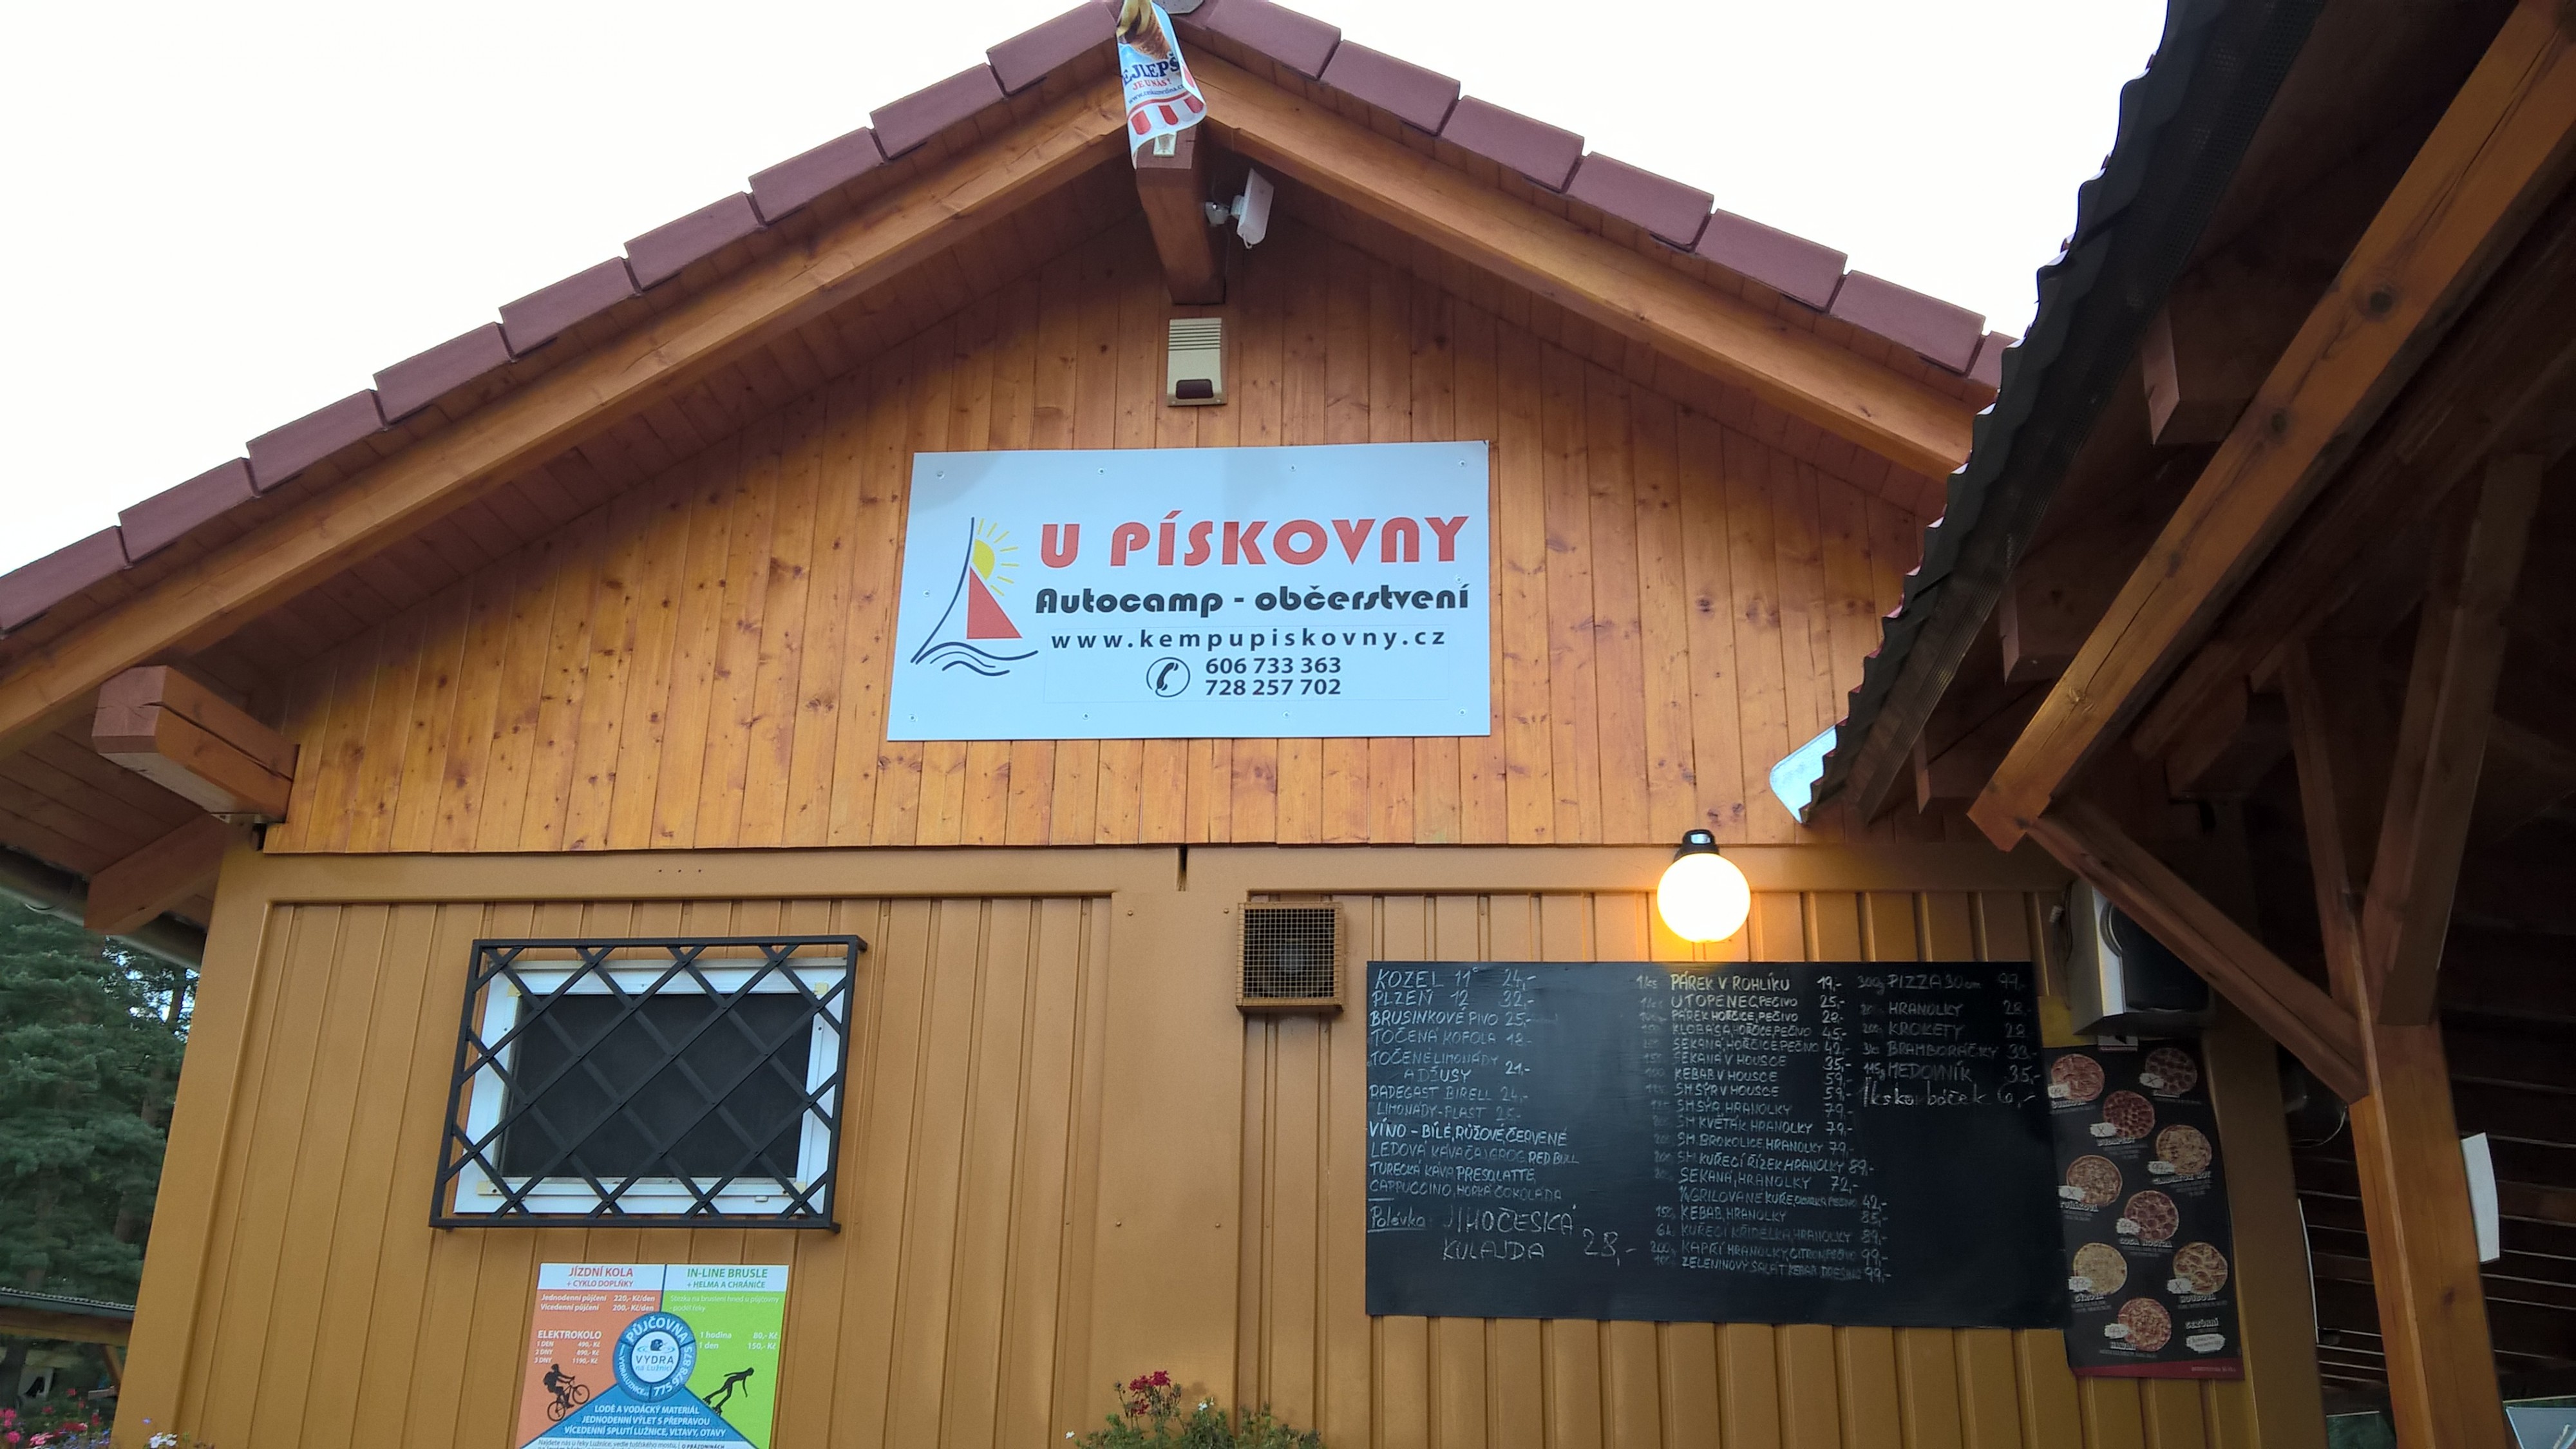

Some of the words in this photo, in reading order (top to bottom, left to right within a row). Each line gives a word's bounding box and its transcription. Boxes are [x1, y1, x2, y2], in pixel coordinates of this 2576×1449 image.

[1041, 523, 1080, 569] U
[1110, 509, 1470, 567] PÍSKOVNY
[1036, 587, 1224, 618] Autocamp
[1255, 584, 1470, 612] občerstvení
[1051, 626, 1447, 653] www.kempupiskovny.cz
[1206, 658, 1247, 674] 606
[1253, 658, 1294, 674] 733
[1301, 657, 1341, 674] 363
[1205, 679, 1247, 696] 728
[1253, 679, 1294, 696] 257
[1300, 678, 1341, 696] 702
[1375, 969, 1444, 990] KOZEL
[1670, 970, 1714, 990] PÁREK
[1718, 976, 1727, 990] V
[1732, 972, 1791, 991] ROHLÍKU
[1887, 974, 1942, 990] PIZZA
[1372, 988, 1434, 1007] PLZEŇ
[1450, 989, 1469, 1007] 12
[1370, 1007, 1467, 1028] BRUSINKOVÉ
[1469, 1012, 1499, 1025] PIVO
[1888, 1001, 1965, 1018] HRANOLKY
[1370, 1028, 1439, 1046] TOČENÁ
[1443, 1031, 1497, 1045] KOFOLA
[1434, 1050, 1499, 1067] LIMONÁDY
[1725, 1054, 1733, 1065] V
[1736, 1054, 1787, 1066] HOUSCE
[1674, 1068, 1714, 1082] KEBAB
[1717, 1070, 1725, 1082] V
[1728, 1070, 1778, 1083] HOUSCE
[1368, 1084, 1440, 1099] RADEGAST
[1444, 1086, 1492, 1101] BIRELL
[1719, 1086, 1727, 1096] V
[1730, 1086, 1780, 1097] HOUSCE
[1725, 1102, 1793, 1115] HRANOLKY
[1369, 1119, 1408, 1139] VÍNO
[1750, 1119, 1813, 1133] HRANOLKY
[1370, 1140, 1428, 1158] LEDOVÁ
[1528, 1151, 1551, 1166] RED
[1766, 1139, 1823, 1153] HRANOLKY
[1369, 1159, 1422, 1177] TURECKÁ
[1425, 1161, 1454, 1179] KÁVA
[1738, 1173, 1812, 1189] HRANOLKY
[1370, 1205, 1425, 1228] Polévka
[1727, 1206, 1786, 1222] HRANOLKY
[1443, 1237, 1546, 1261] KULAJDA
[569, 1265, 605, 1277] JÍZDNÍ
[605, 1267, 634, 1278] KOLA
[687, 1268, 725, 1278] IN-LINE
[728, 1269, 768, 1278] BRUSLE
[598, 1279, 634, 1287] DOPLŇKY
[728, 1280, 766, 1288] CHRÁNIČE
[537, 1330, 603, 1340] ELEKTROKOLO
[625, 1315, 688, 1343] PŮJČOVNA
[635, 1355, 674, 1365] VYDRA
[653, 1381, 673, 1397] 775
[661, 1405, 700, 1414] MATERIÁL
[582, 1416, 632, 1425] JEDNODENNÍ
[632, 1415, 656, 1425] VÝLET
[607, 1426, 633, 1435] SPLUTÍ
